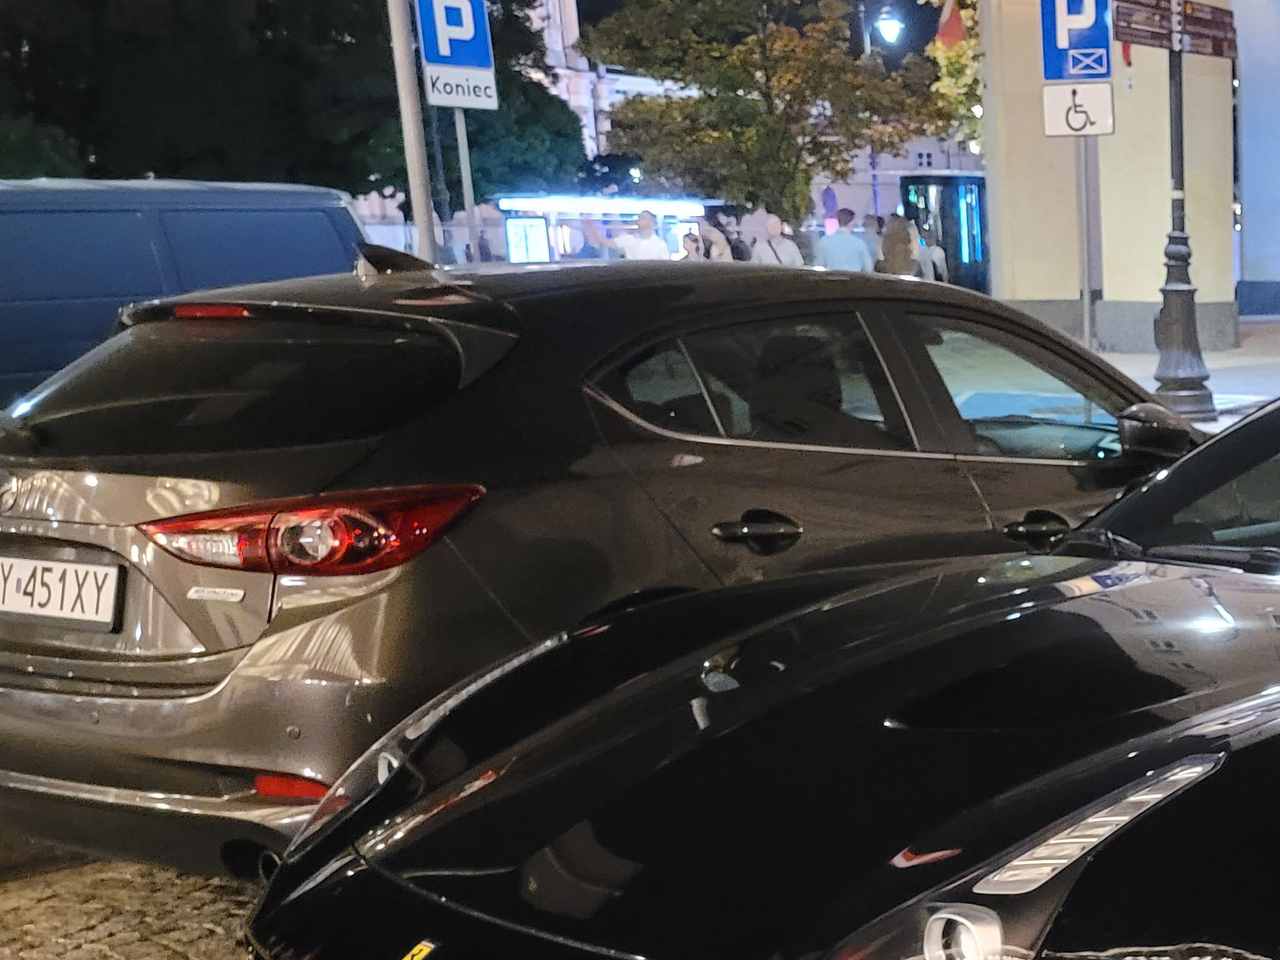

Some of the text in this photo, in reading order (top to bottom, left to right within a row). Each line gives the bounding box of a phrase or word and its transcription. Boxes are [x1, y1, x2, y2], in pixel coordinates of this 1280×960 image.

[432, 0, 475, 57] P
[1055, 0, 1097, 49] P
[430, 75, 493, 98] Koniec
[23, 565, 109, 616] 451XY
